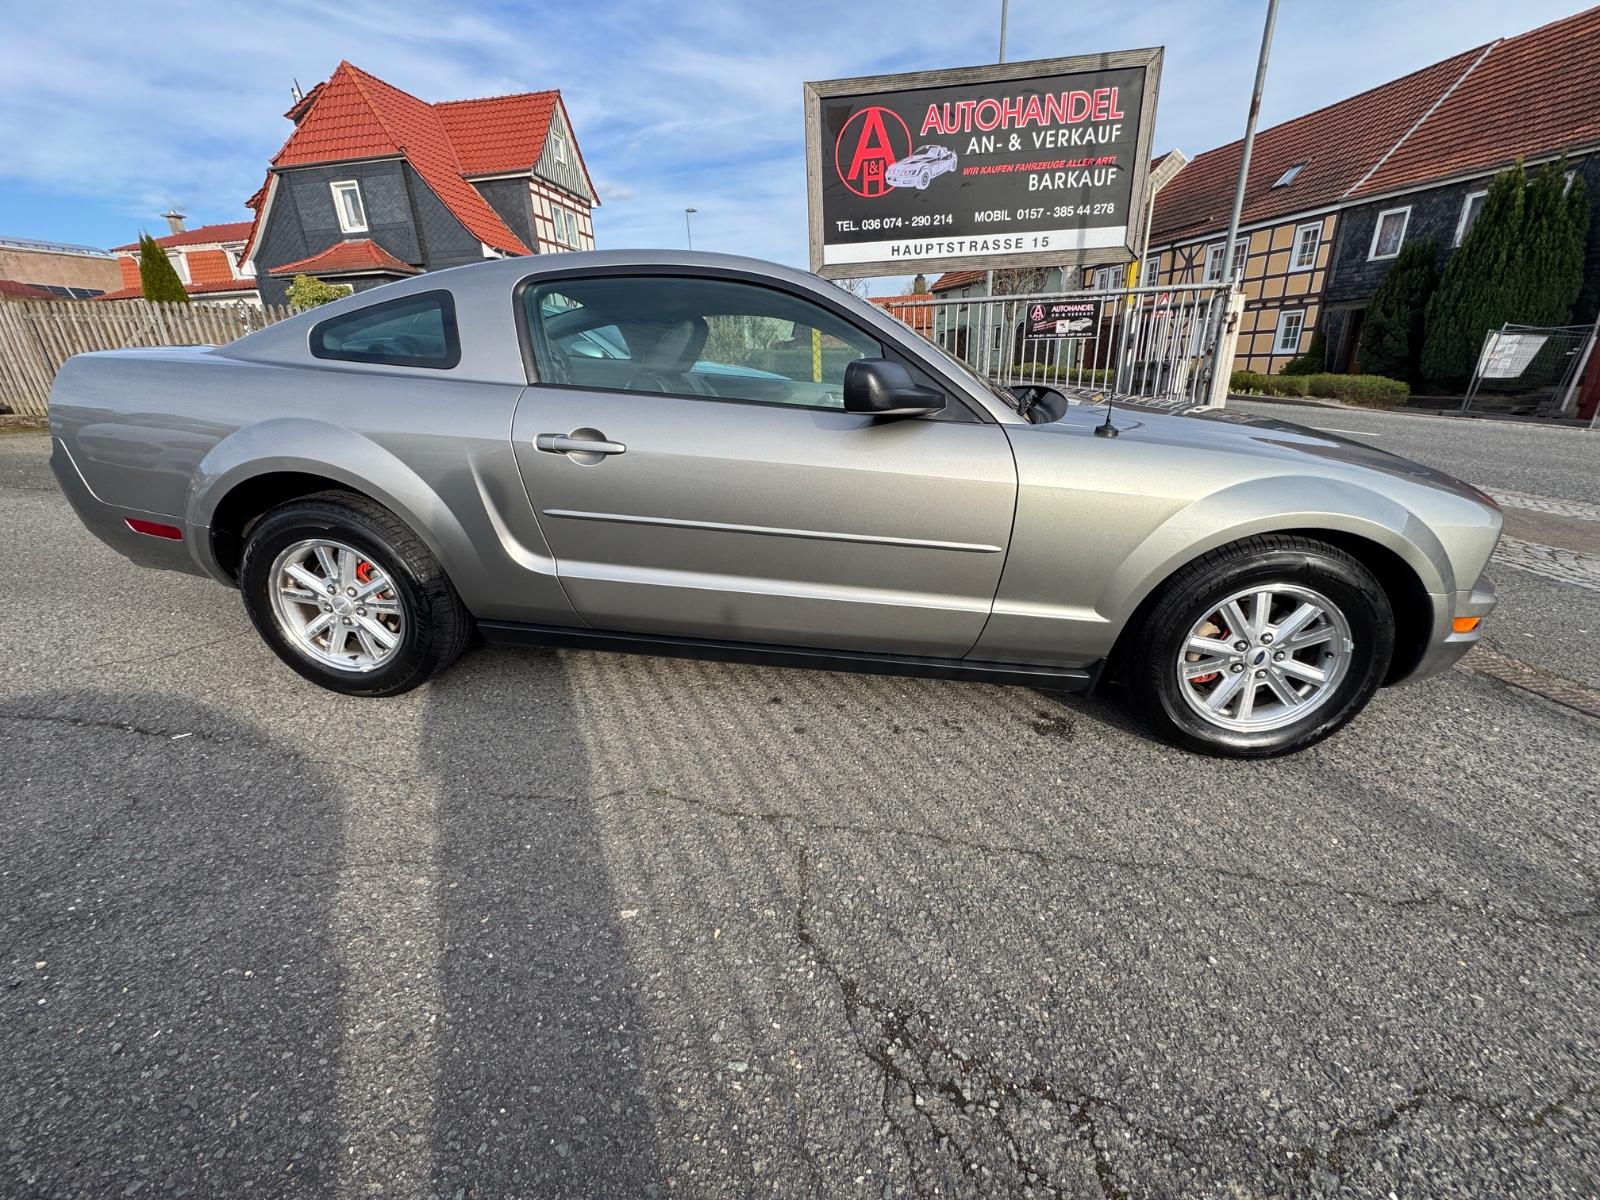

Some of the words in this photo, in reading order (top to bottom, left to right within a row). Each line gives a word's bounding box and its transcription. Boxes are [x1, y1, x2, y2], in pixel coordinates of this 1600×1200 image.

[920, 87, 1124, 136] AUTOHANDEL
[966, 134, 1003, 155] AN-
[1008, 133, 1022, 151] &
[1032, 124, 1122, 149] VERKAUF
[963, 167, 979, 176] WIR
[980, 164, 1013, 174] KAUFEN
[1015, 160, 1065, 171] FAHRZEUGE
[1066, 157, 1094, 168] ALLER
[1028, 168, 1117, 191] BARKAUF
[836, 220, 859, 231] TEL.
[861, 219, 881, 230] 036
[883, 217, 902, 228] 074
[911, 215, 931, 227] 290
[933, 213, 953, 225] 214
[974, 209, 1011, 222] MOBIL
[1017, 208, 1044, 220] 0157
[1053, 206, 1074, 218] 385
[1076, 205, 1091, 215] 44
[1093, 203, 1114, 214] 278
[891, 237, 1024, 256] HAUPTSTRASSE
[1032, 236, 1049, 248] 15
[1051, 304, 1094, 312] AUTOHANDEL
